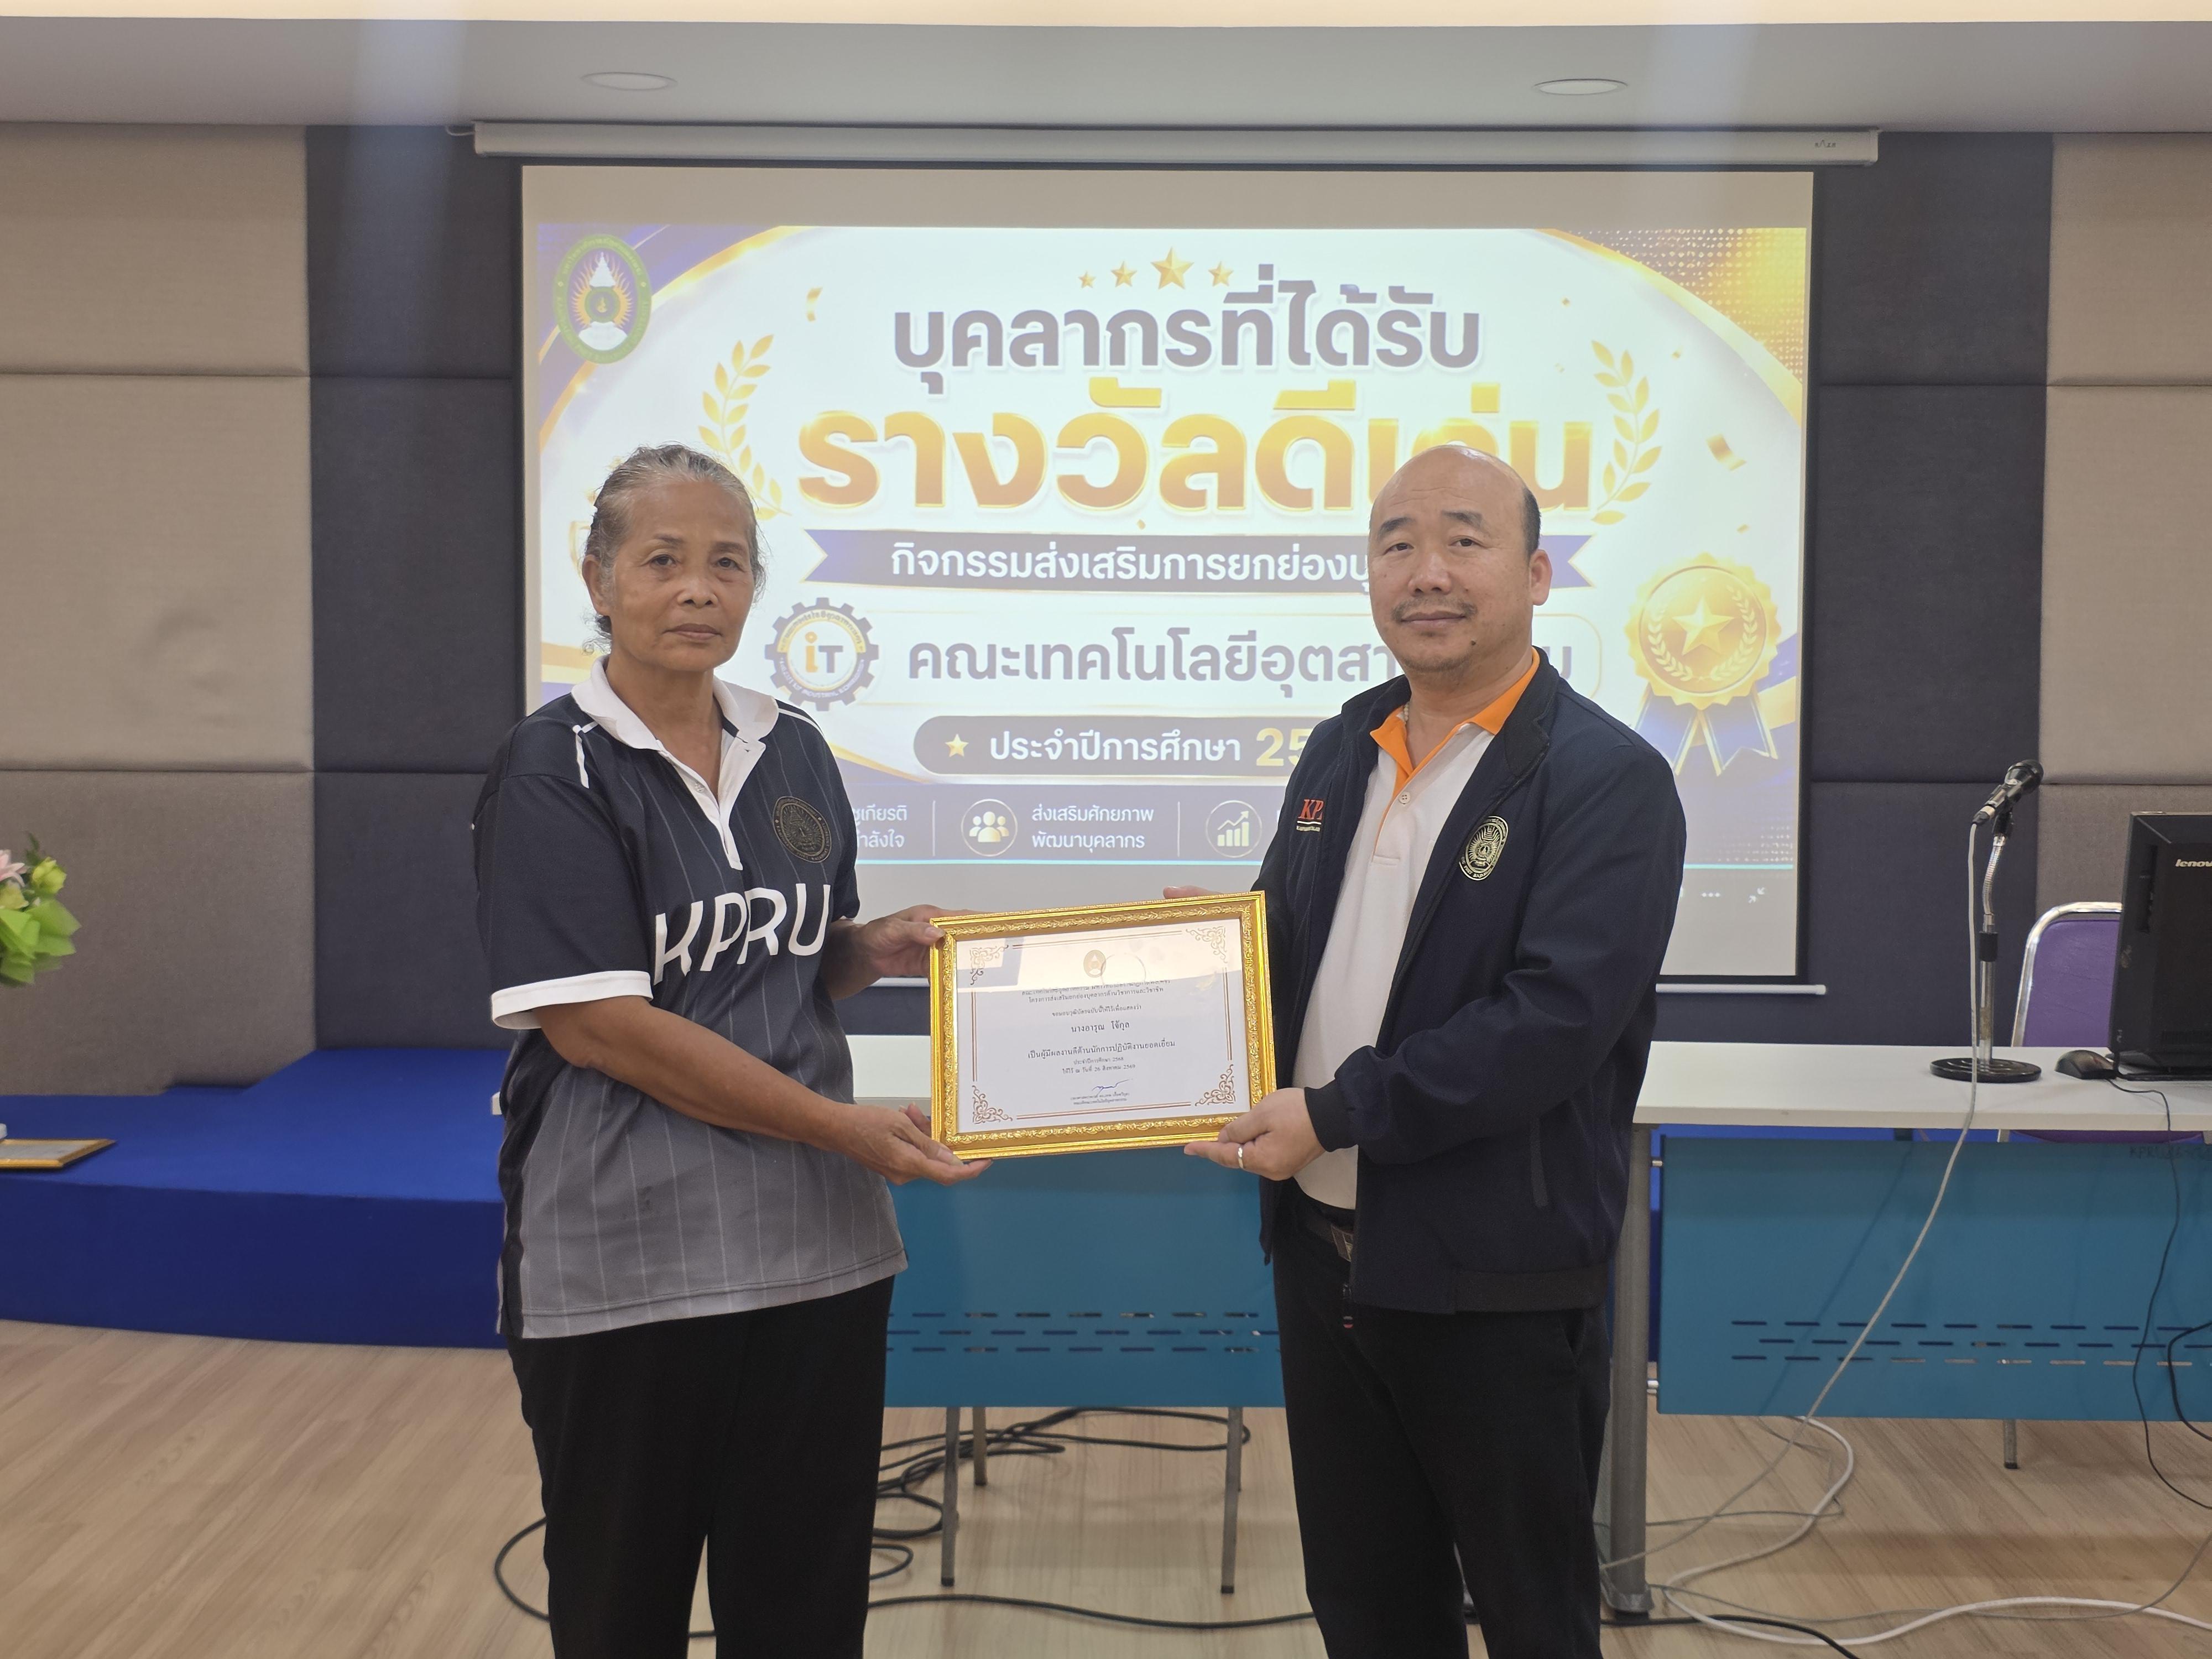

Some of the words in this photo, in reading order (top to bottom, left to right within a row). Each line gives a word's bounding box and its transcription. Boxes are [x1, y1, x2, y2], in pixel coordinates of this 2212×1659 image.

[894, 264, 1480, 394] บุคลากรที่ได้รับ
[990, 728, 1240, 761] ประจำปีการศึกษา
[1032, 804, 1154, 822] ส่งเสริมศักยภาพ
[1298, 799, 1324, 820] KP
[1032, 831, 1145, 853] พัฒนาบุคลากร
[654, 883, 831, 985] KPRU
